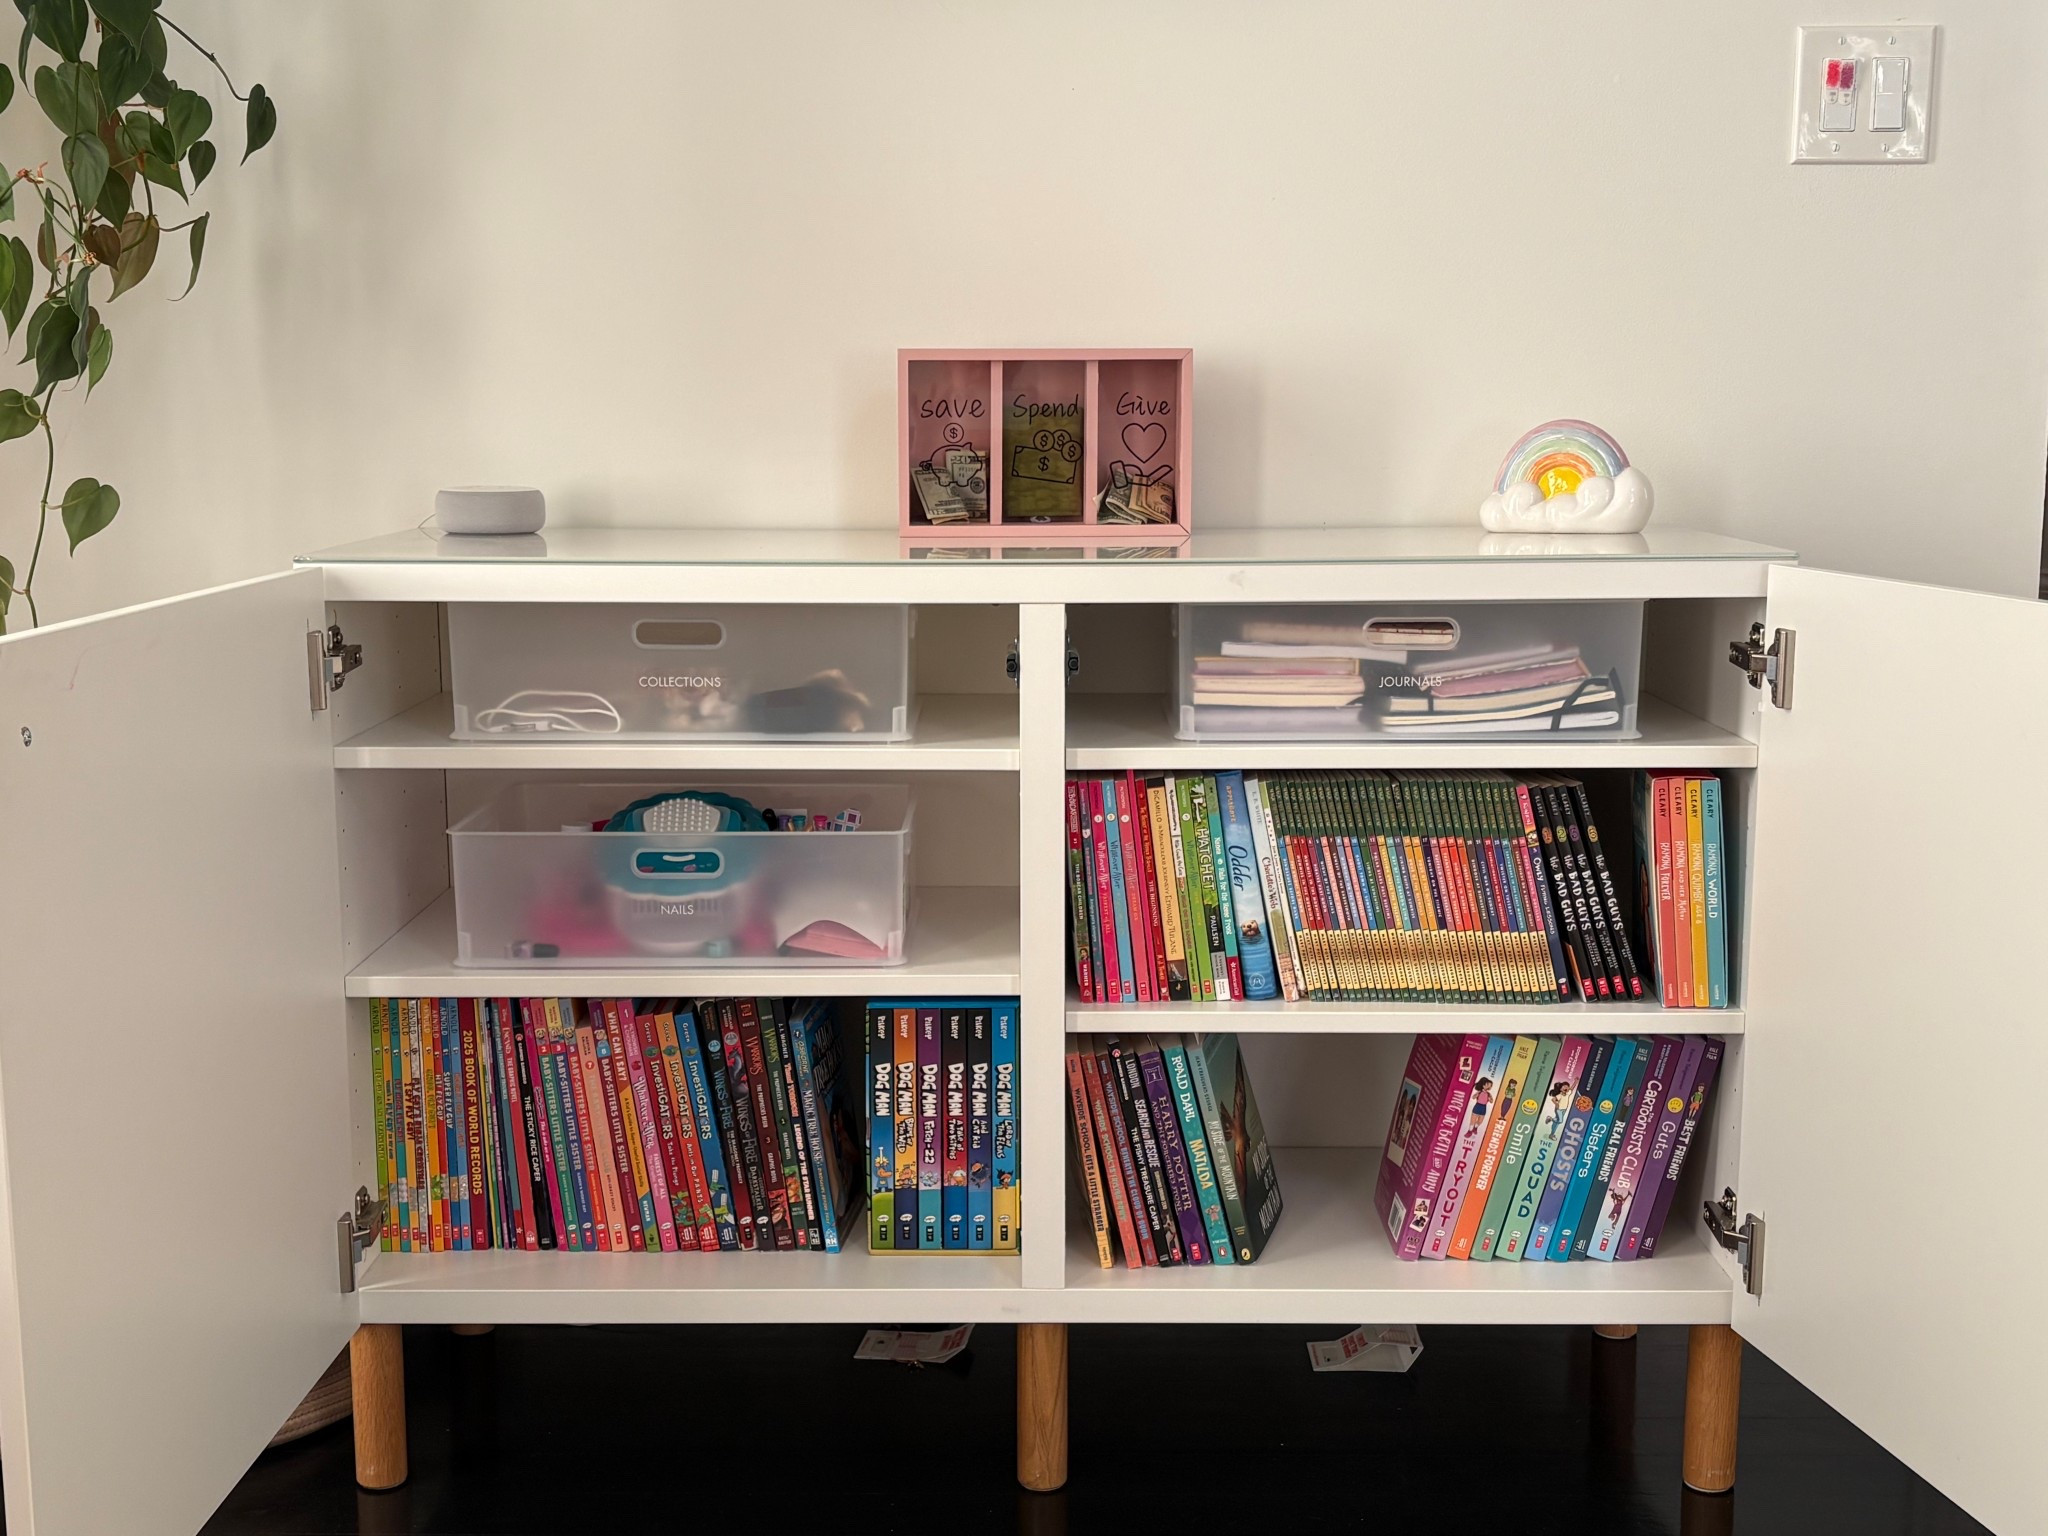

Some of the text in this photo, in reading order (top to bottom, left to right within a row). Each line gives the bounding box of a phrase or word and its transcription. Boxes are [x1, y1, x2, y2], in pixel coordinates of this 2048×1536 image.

[1012, 393, 1080, 425] Spend
[1115, 391, 1171, 416] Give
[638, 676, 721, 688] COLLECTIONS
[1378, 676, 1442, 688] JOURNALS
[1658, 788, 1666, 817] CLEARY
[1674, 786, 1682, 816] CLEARY
[1690, 789, 1698, 819] CLEARY
[1706, 789, 1714, 818] CLEARY
[1194, 827, 1215, 891] HATCHET
[1228, 845, 1251, 891] Odder
[1576, 854, 1587, 869] the
[1594, 854, 1606, 870] the
[1660, 842, 1672, 901] RAMONA FOREVER
[1675, 840, 1686, 869] RAMONA
[1690, 843, 1702, 871] RAMONA
[1261, 856, 1275, 892] Charlotte's
[1269, 893, 1279, 909] Web
[1549, 856, 1577, 932] the BAD GUYS
[1563, 855, 1592, 931] the BAD GUYS
[1582, 869, 1596, 895] BAD
[1600, 871, 1614, 896] BAD
[1707, 879, 1718, 919] WORLD
[660, 904, 694, 915] NAILS
[1588, 896, 1606, 930] GUYS
[1606, 897, 1624, 931] GUYS
[1210, 915, 1220, 946] PAULSEN
[372, 1005, 381, 1034] ARNOLD
[381, 1003, 390, 1033] ARNOLD
[391, 1006, 400, 1036] ARNOLD
[401, 1007, 410, 1036] ARNOLD
[431, 1009, 440, 1039] ARNOLD
[440, 1007, 449, 1036] ARNOLD
[450, 1005, 459, 1034] ARNOLD
[644, 1022, 653, 1043] Green
[607, 1011, 628, 1082] WHAT CAN SAY?
[745, 1036, 765, 1076] WARRIORS
[763, 1028, 781, 1063] WARRIORS
[541, 1057, 557, 1115] BABY-SITTERS
[601, 1059, 619, 1117] BABY-SITTERS
[874, 1063, 891, 1116] DOG MAN
[897, 1062, 914, 1116] DOG MAN
[921, 1064, 938, 1117] DOG MAN
[947, 1063, 964, 1116] DOG MAN
[971, 1063, 988, 1116] DOG MAN
[996, 1063, 1013, 1117] DOG MAN
[1124, 1059, 1141, 1089] LONDON
[1171, 1055, 1196, 1122] ROALD DAHL
[443, 1071, 454, 1129] SUPER FLY GUY
[462, 1030, 482, 1195] 2025 BOOK OF WORLD RECORDS
[556, 1055, 582, 1171] BABY-SITTERS LITTLE SISTER
[570, 1057, 595, 1172] BABY-SITTERS LITTLE SISTER
[633, 1076, 657, 1149] Whatever After
[1073, 1088, 1086, 1121] WAYSIDE
[1105, 1081, 1118, 1114] WAYSIDE
[550, 1116, 563, 1143] LITTLE
[611, 1118, 624, 1144] LITTLE
[718, 1106, 735, 1129] FIRE
[801, 1089, 823, 1162] MAGIC TREE HOUSE
[1093, 1099, 1115, 1165] WAYSIDE SCHOOL
[1112, 1115, 1126, 1146] SCHOOL
[1134, 1099, 1161, 1169] SEARCH AND RESCUE
[524, 1095, 541, 1182] THE STICKY RICE CAPER
[743, 1137, 760, 1164] FIRE
[1079, 1122, 1092, 1153] SCHOOL
[1157, 1095, 1193, 1211] HARRY POTTER
[1506, 1122, 1531, 1165] Smile
[1550, 1117, 1585, 1192] GHOSTS
[1577, 1122, 1607, 1178] Sisters
[1597, 1120, 1625, 1183] REAL FRIENDS
[1652, 1121, 1676, 1160] Guts
[1666, 1119, 1696, 1181] BEST FRIENDS
[555, 1144, 567, 1172] SISTER
[616, 1145, 629, 1173] SISTER
[793, 1123, 815, 1221] LEGEND OF THE STAR RUNNER
[1085, 1154, 1095, 1171] GETS
[1120, 1147, 1133, 1175] BENEATH
[1151, 1101, 1182, 1214] AND THE STONE
[1188, 1138, 1213, 1190] MATILDA
[1207, 1121, 1239, 1201] MY SIDE MOUNTAIN
[1475, 1119, 1507, 1191] FRIENDS FOREVER
[1089, 1177, 1100, 1198] LITTLE
[1130, 1126, 1160, 1231] THE FISHY TREASURE CAPER
[1439, 1147, 1471, 1228] TRYOUT
[1517, 1148, 1548, 1219] SQUAD
[1616, 1156, 1638, 1189] CLUB
[642, 1200, 651, 1222] NEWMAN
[1091, 1199, 1105, 1232] STRANGER
[1129, 1188, 1142, 1211] CLOUD
[1135, 1211, 1144, 1219] OF
